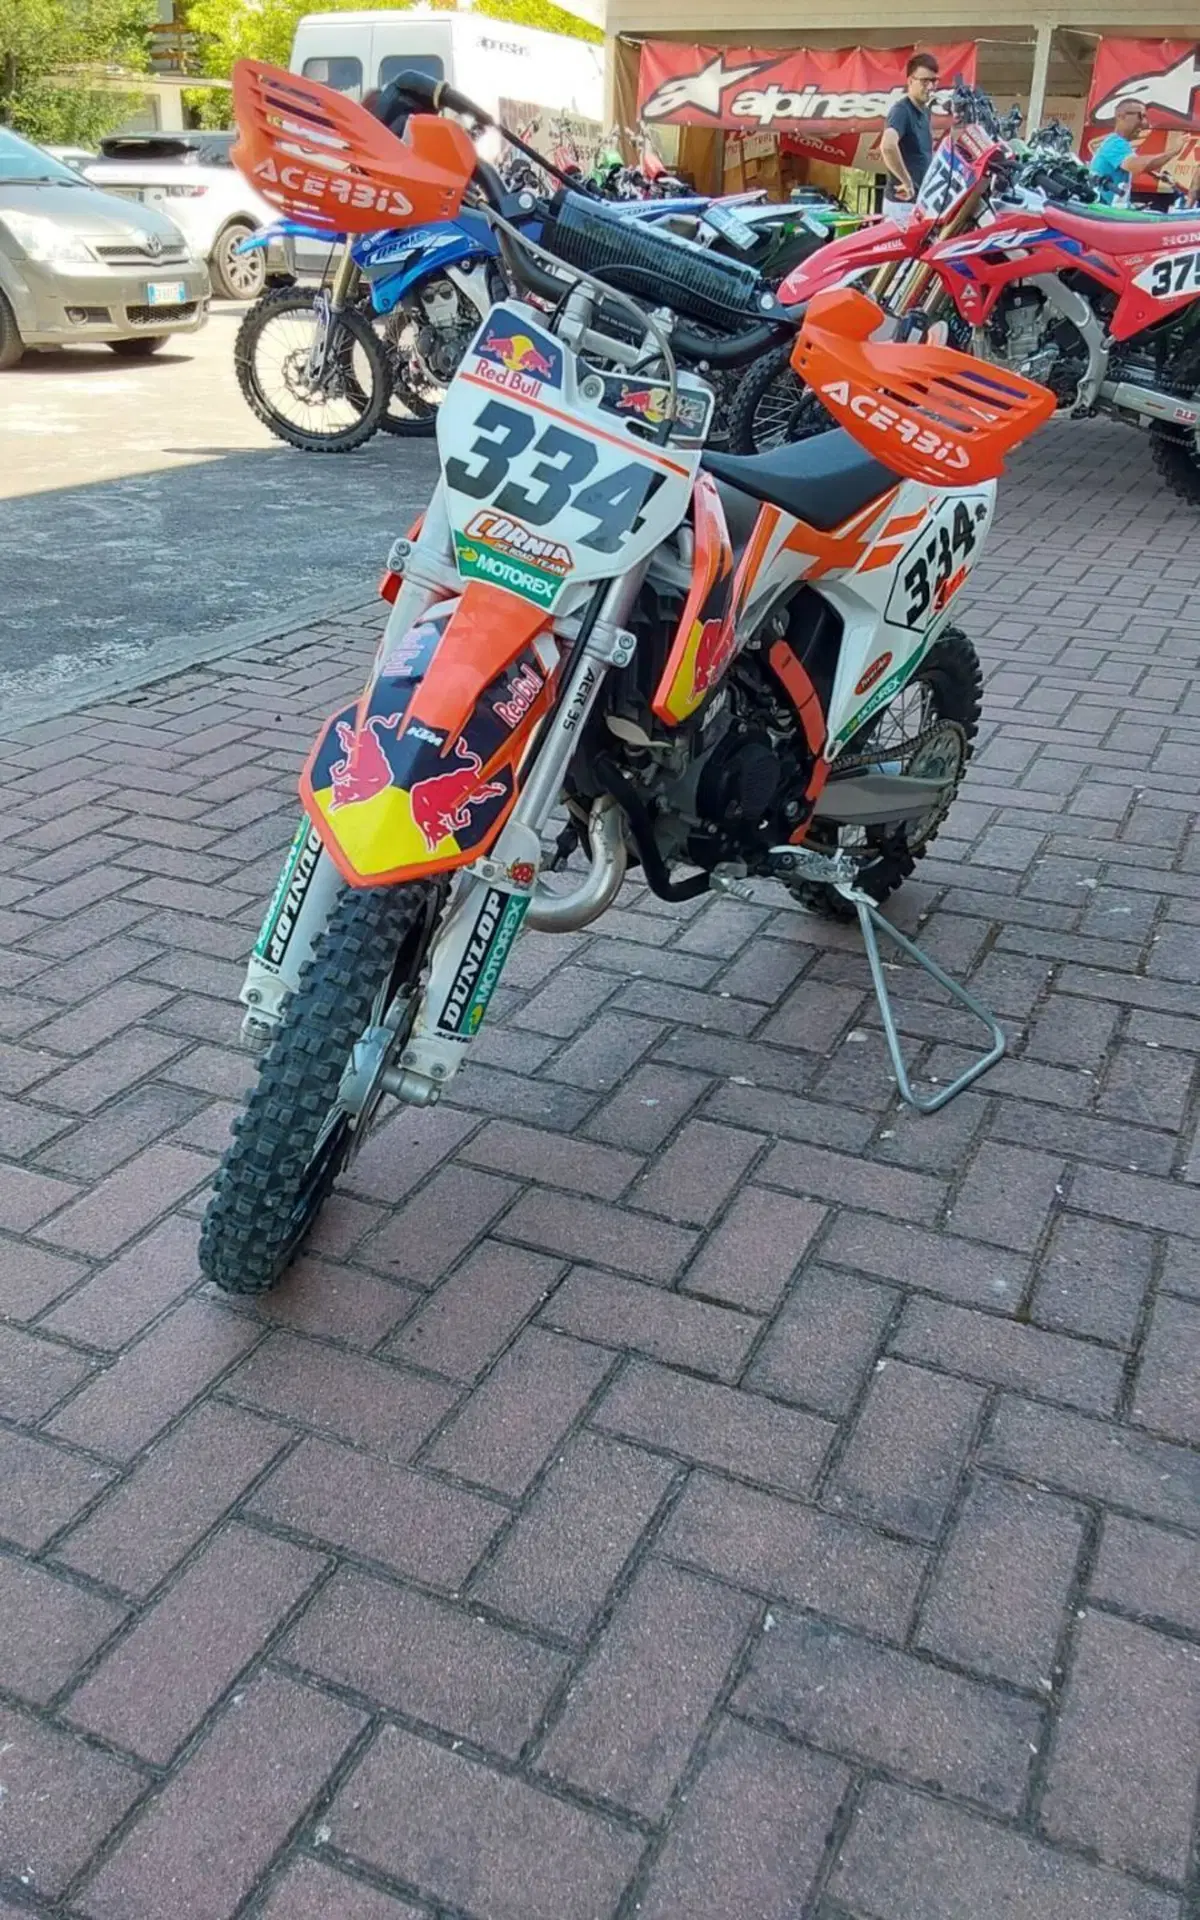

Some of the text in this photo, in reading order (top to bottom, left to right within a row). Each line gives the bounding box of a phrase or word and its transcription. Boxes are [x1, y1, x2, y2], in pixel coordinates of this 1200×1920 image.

[475, 360, 543, 399] Red Bull
[445, 399, 667, 555] 334
[464, 510, 574, 568] CORNIA
[536, 558, 567, 575] TEAM
[904, 500, 976, 628] 334
[476, 553, 556, 599] MOTOREX
[563, 666, 597, 732] AER 35
[406, 726, 445, 748] KTM
[270, 826, 323, 962] DUNLOP
[442, 891, 502, 1030] DUNLOP
[475, 901, 525, 1004] MOTOREX
